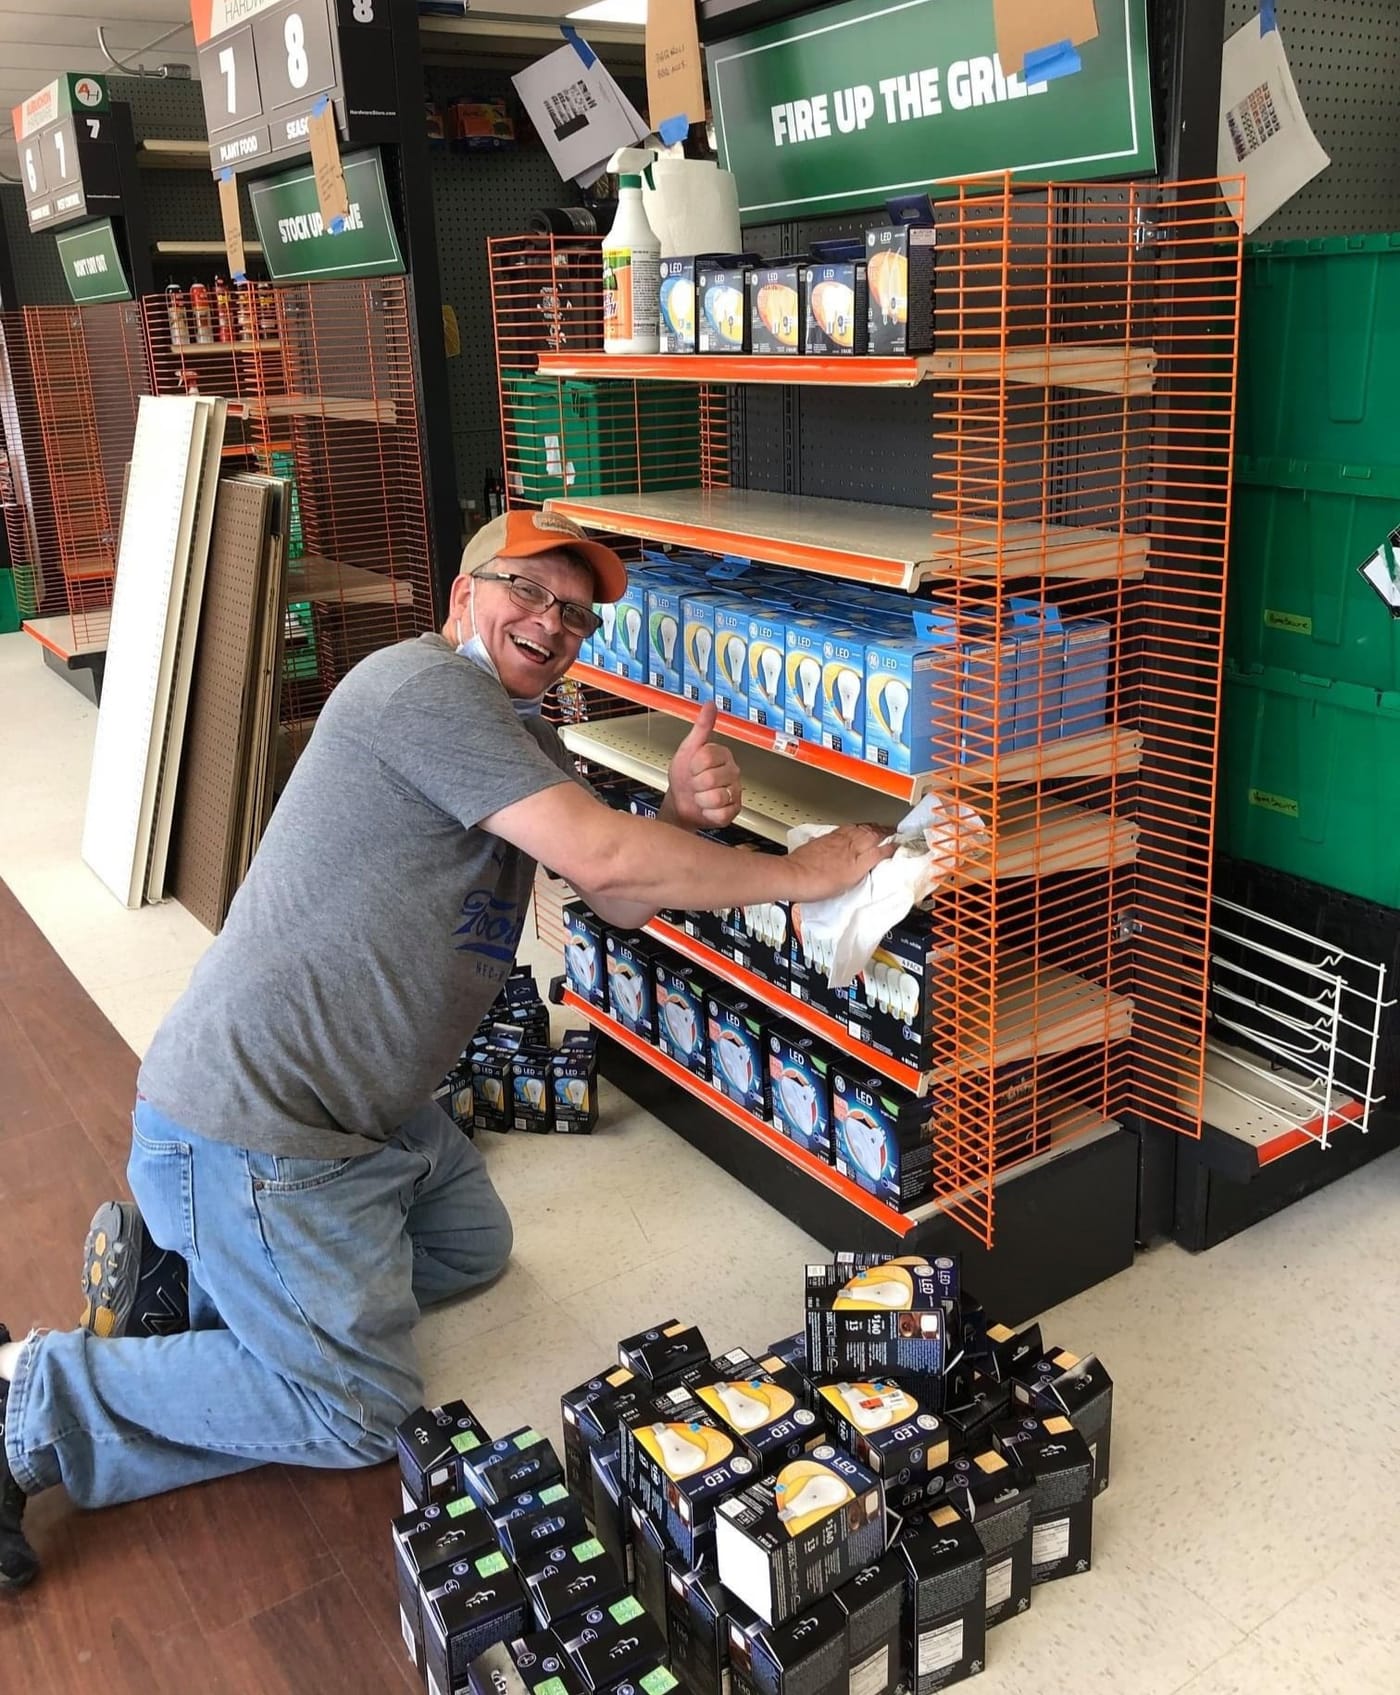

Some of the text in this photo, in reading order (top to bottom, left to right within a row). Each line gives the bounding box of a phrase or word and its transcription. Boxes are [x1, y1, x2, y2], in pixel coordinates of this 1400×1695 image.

[284, 13, 308, 88] 8
[219, 47, 236, 114] 7
[771, 94, 831, 146] FIRE
[833, 85, 874, 133] UP
[879, 67, 942, 124] THE
[86, 119, 100, 139] 7
[220, 136, 258, 162] PLANT FOOD
[26, 148, 37, 192] 6
[278, 213, 311, 243] STOCK
[310, 212, 323, 237] UP
[881, 232, 892, 241] LED
[670, 262, 682, 274] LED
[824, 269, 834, 278] LED
[714, 274, 725, 282] LED
[767, 272, 778, 280] LED
[659, 599, 669, 608] LED
[693, 608, 704, 618] LED
[725, 617, 737, 626] LED
[760, 627, 771, 637] LED
[798, 636, 811, 647] LED
[835, 647, 849, 658] LED
[881, 657, 897, 669] LED
[644, 807, 656, 820] LED
[575, 919, 586, 932] LED
[621, 946, 632, 960] LED
[907, 961, 921, 971] PACK
[672, 977, 685, 992] LED
[726, 1011, 740, 1027] LED
[789, 1048, 805, 1066] LED
[482, 1067, 493, 1075] LED
[524, 1067, 535, 1075] LED
[566, 1068, 577, 1077] LED
[855, 1087, 873, 1107] LED
[940, 1270, 950, 1285] LED
[922, 1279, 934, 1294] LED
[850, 1320, 858, 1331] 13
[871, 1314, 881, 1335] $140
[771, 1420, 796, 1438] LED
[894, 1425, 919, 1441] LED
[833, 1457, 857, 1474] LED
[705, 1468, 731, 1487] LED
[902, 1489, 923, 1506] LED
[806, 1537, 816, 1552] 13
